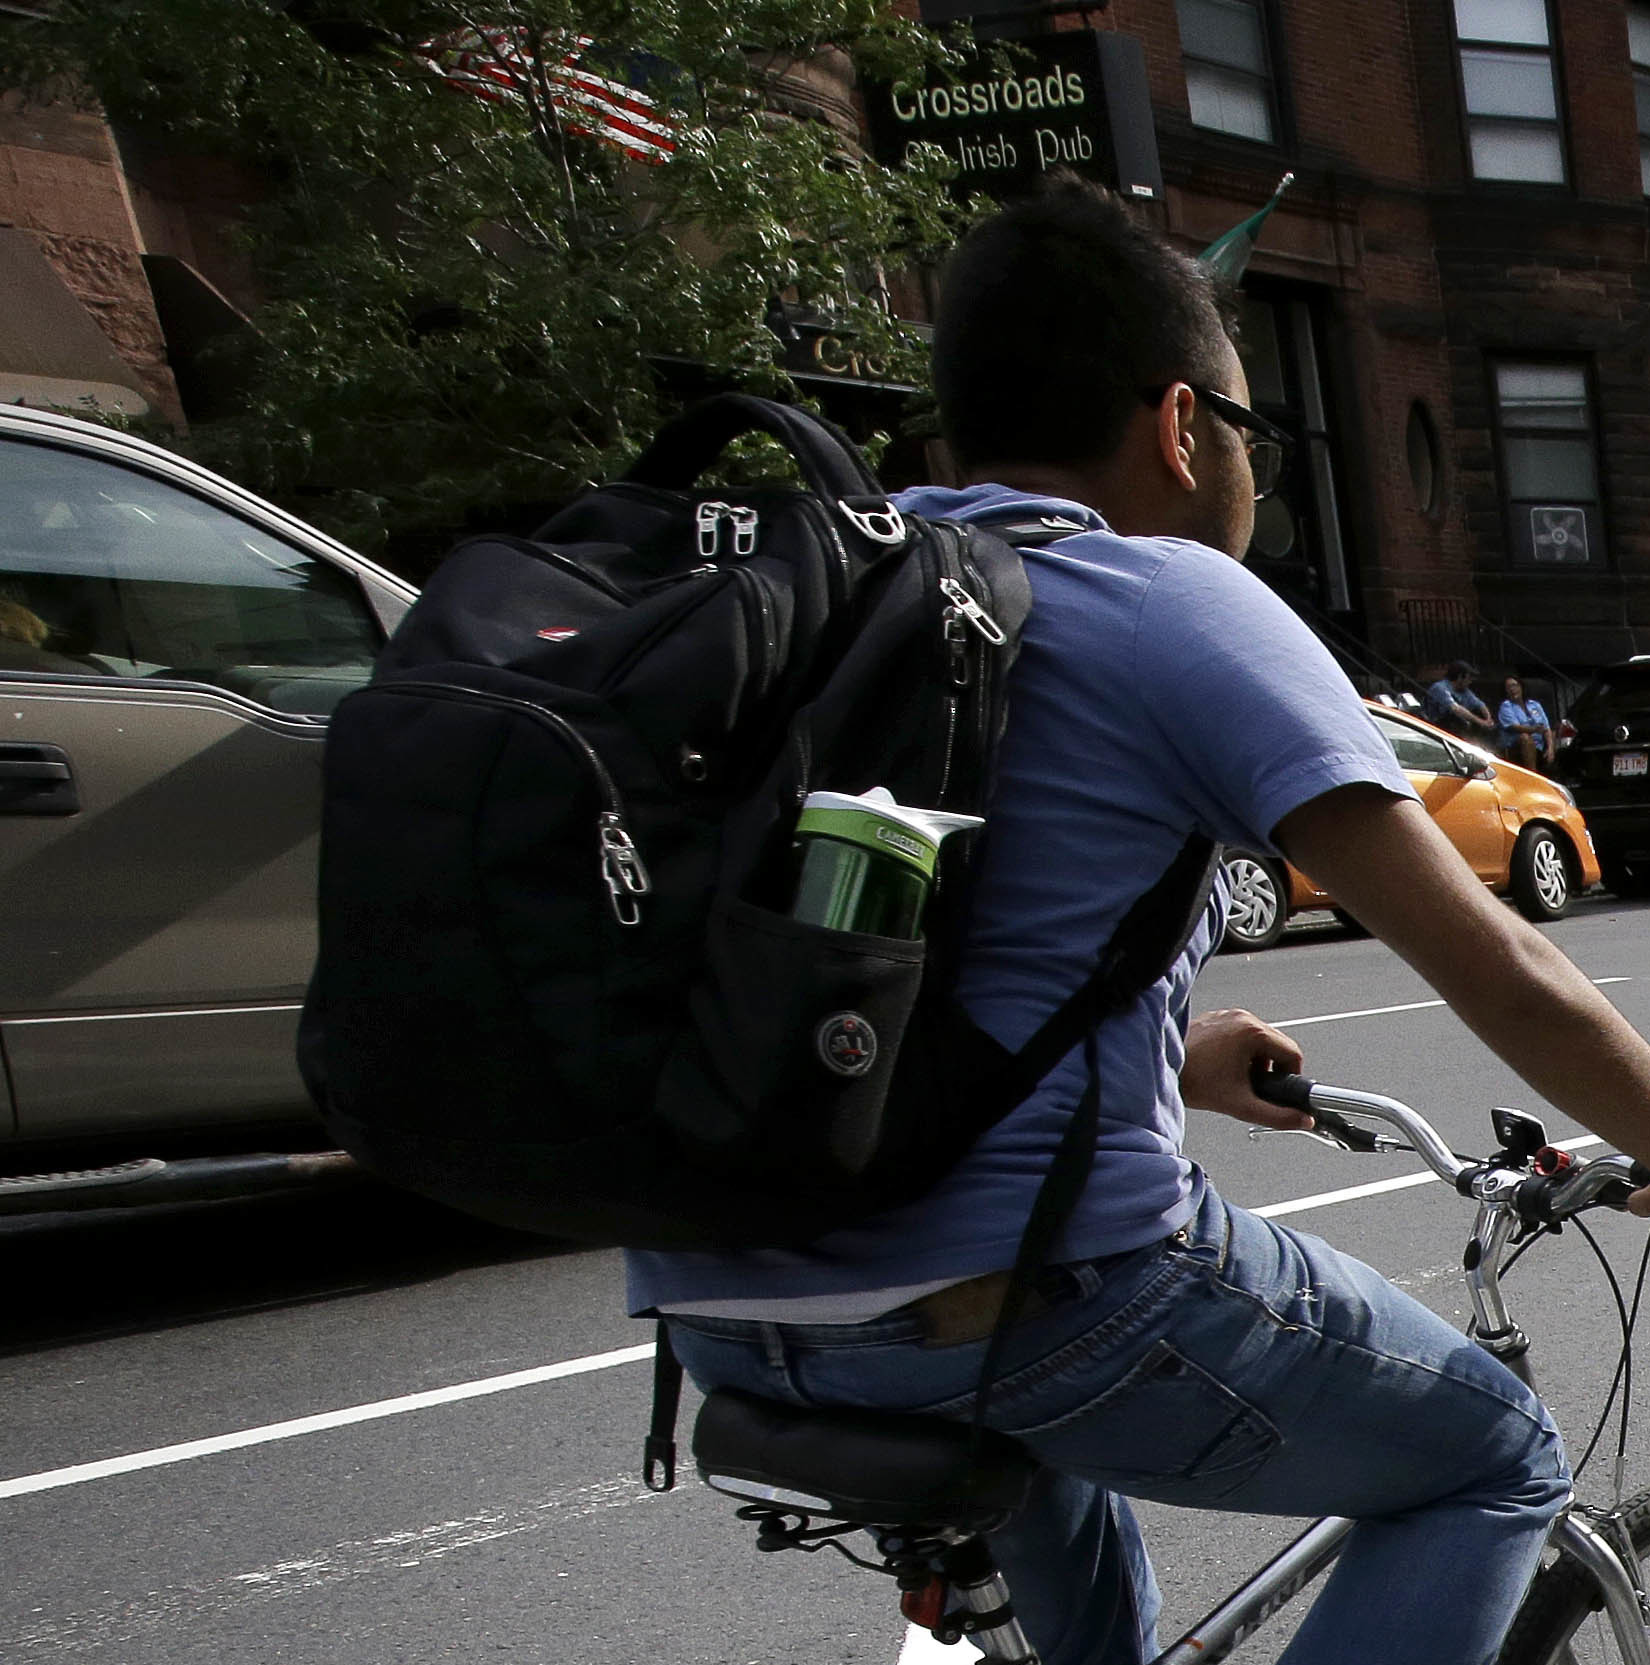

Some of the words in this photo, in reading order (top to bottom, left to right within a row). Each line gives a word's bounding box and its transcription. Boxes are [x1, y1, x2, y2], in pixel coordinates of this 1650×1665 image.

[892, 64, 1085, 121] Crossroads
[958, 133, 1017, 171] Irish
[1035, 126, 1093, 171] Pub
